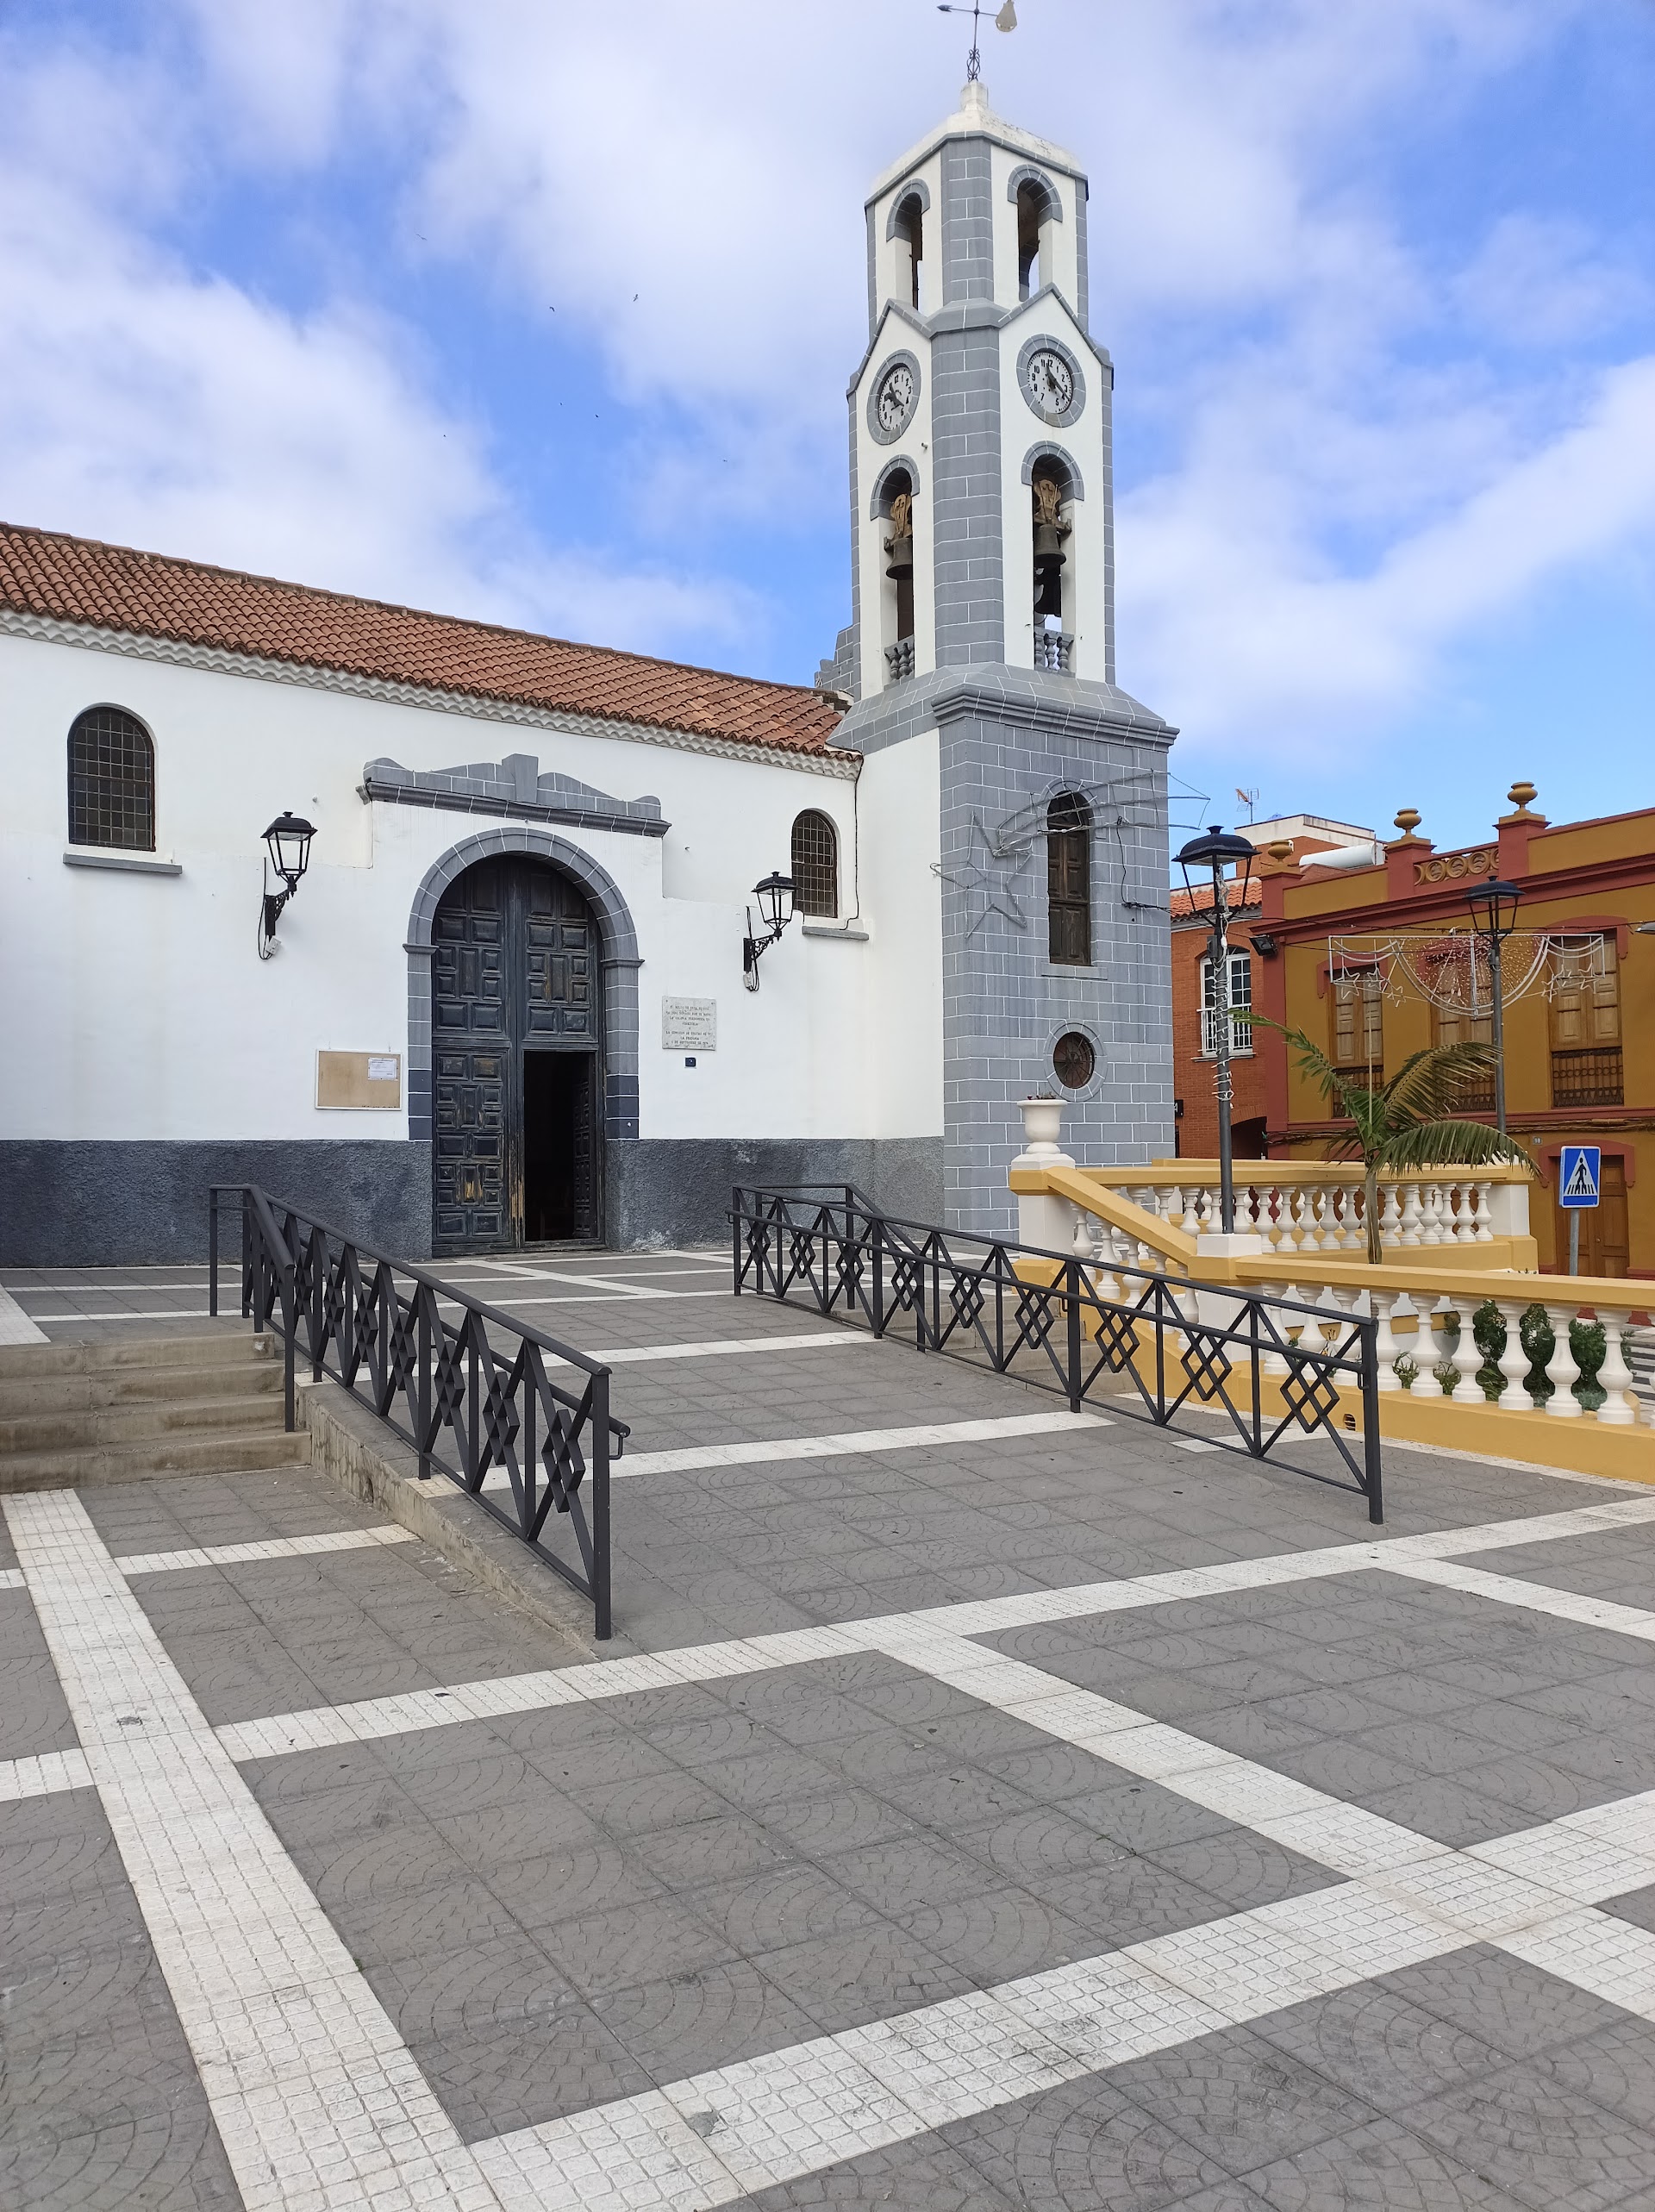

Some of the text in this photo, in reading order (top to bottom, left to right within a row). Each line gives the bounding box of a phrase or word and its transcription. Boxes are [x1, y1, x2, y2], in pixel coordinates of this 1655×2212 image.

[1041, 359, 1045, 368] 11
[1048, 359, 1053, 368] 12
[1034, 365, 1040, 374] 10
[1032, 373, 1036, 381] 9
[1062, 374, 1065, 382] 2
[1034, 384, 1038, 392] 8
[1041, 393, 1044, 401] 7
